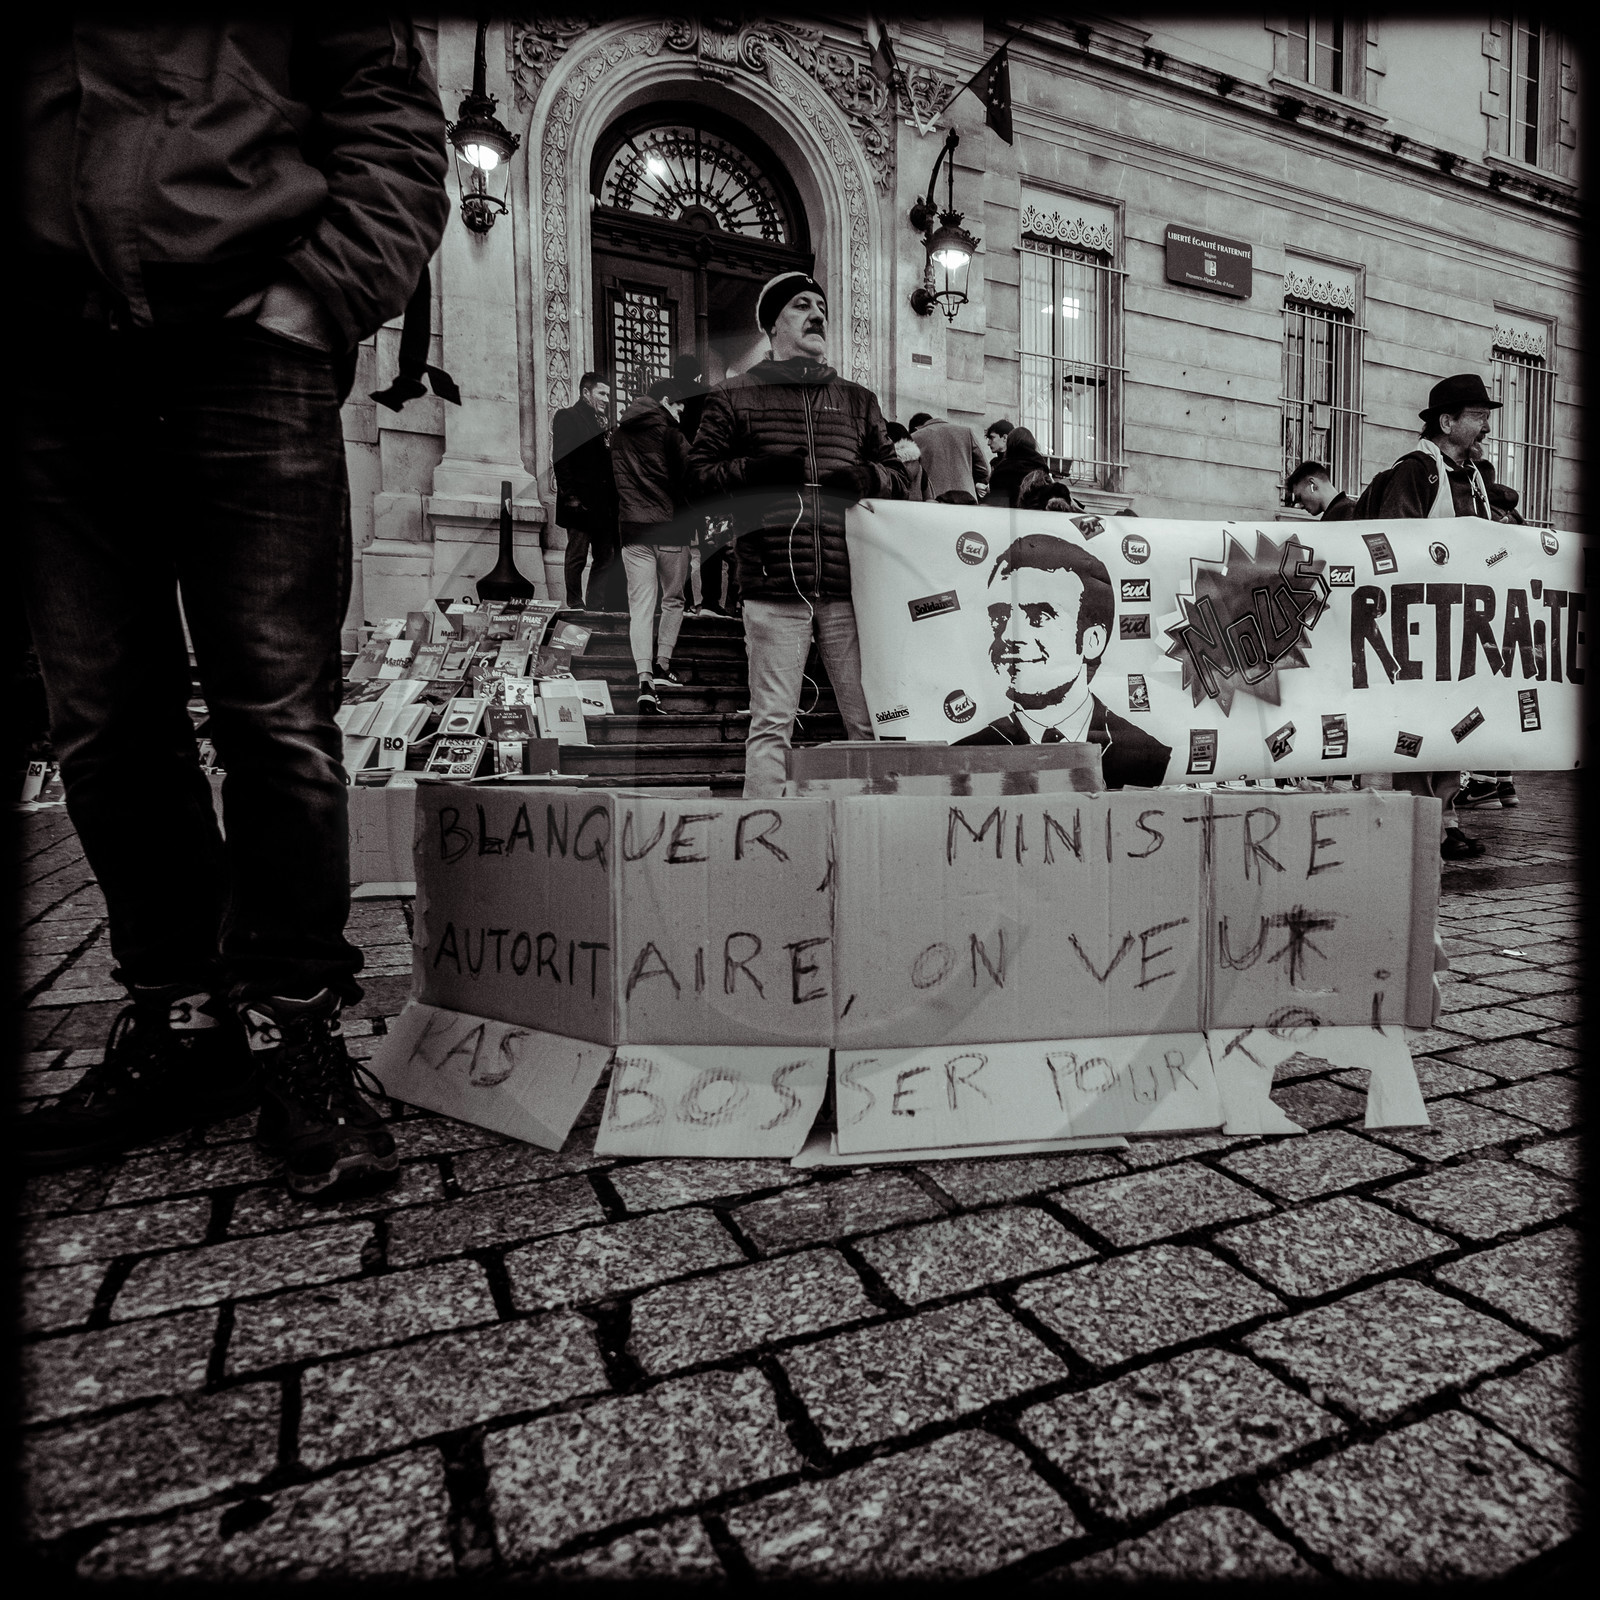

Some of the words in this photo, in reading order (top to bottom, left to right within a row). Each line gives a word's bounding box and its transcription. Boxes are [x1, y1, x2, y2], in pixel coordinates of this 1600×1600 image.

[1167, 231, 1192, 244] LIBERTÉ
[1192, 236, 1217, 251] ÉGALITÉ
[1217, 244, 1252, 260] FRATERNITÉ
[1181, 540, 1331, 699] NOUS
[875, 708, 910, 722] Solidaires
[945, 805, 1351, 886] MINISTRE
[910, 929, 1006, 990] ON
[1043, 1046, 1199, 1112] POUR
